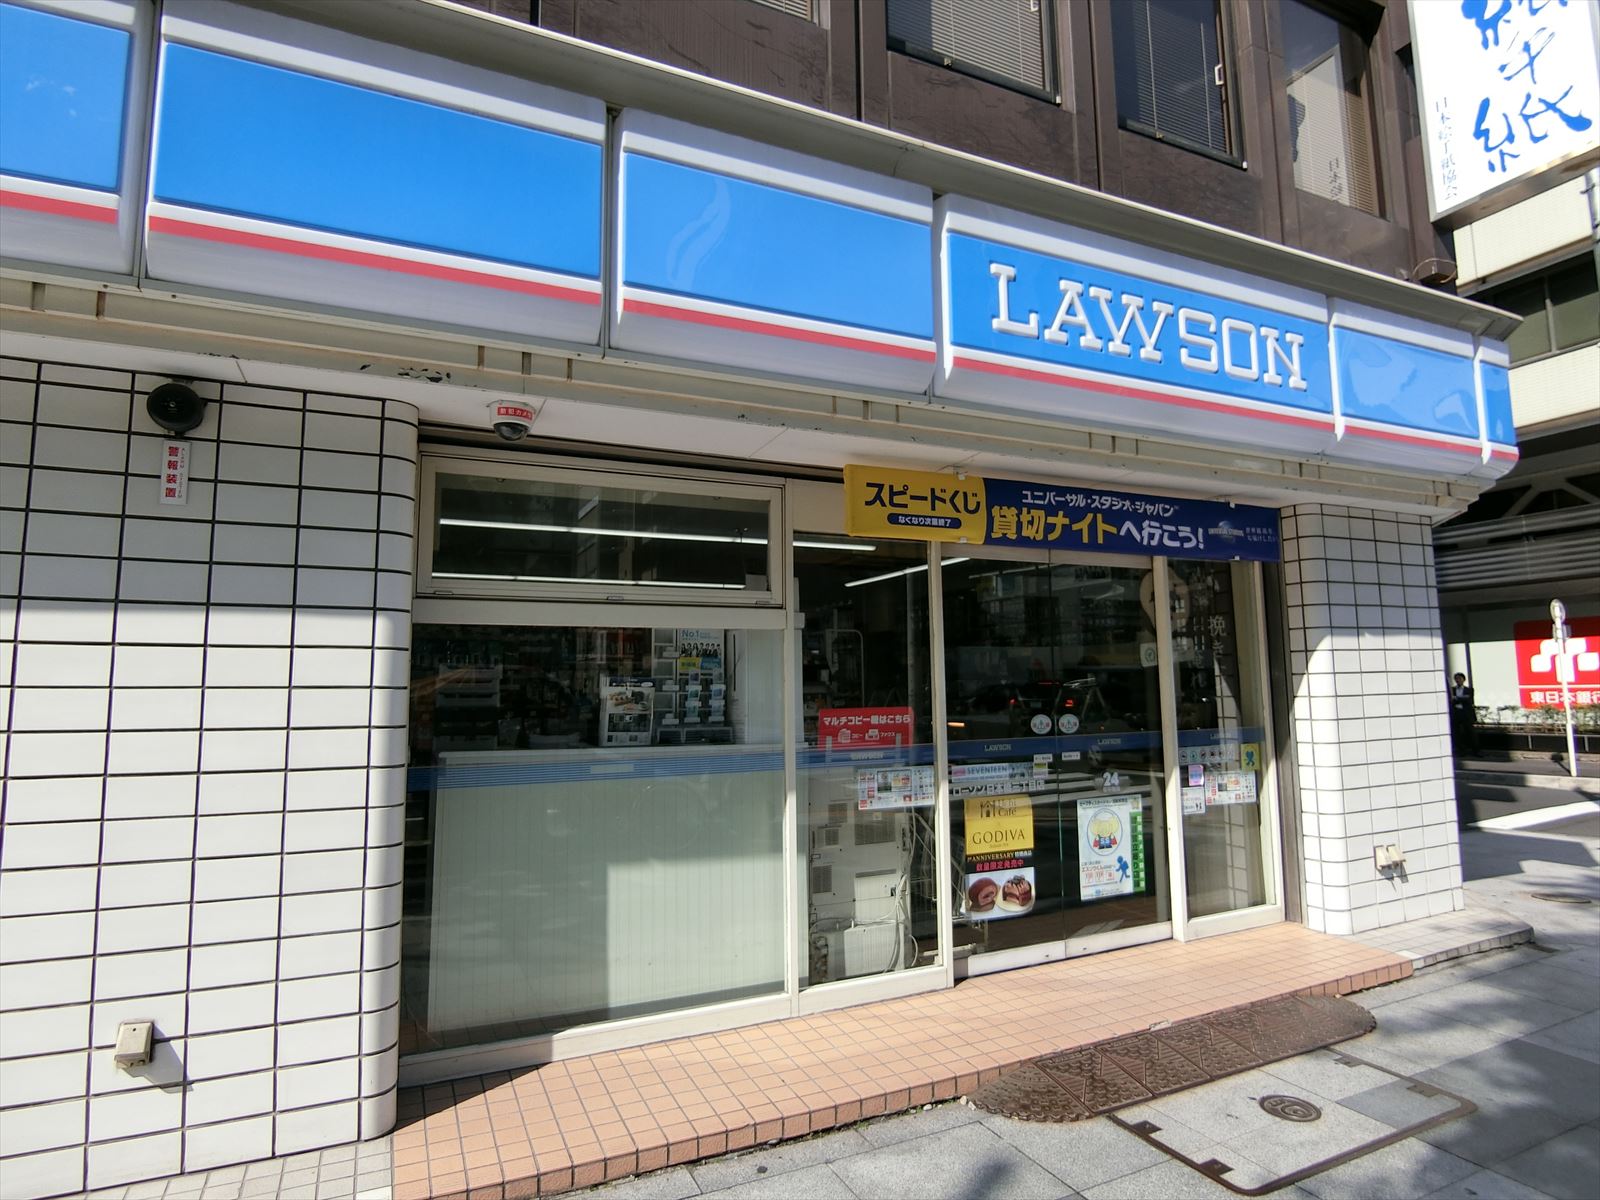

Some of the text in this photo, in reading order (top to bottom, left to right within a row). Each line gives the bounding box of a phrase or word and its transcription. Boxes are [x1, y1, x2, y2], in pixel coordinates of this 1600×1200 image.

[990, 262, 1308, 393] LAWSON
[864, 482, 980, 514] スピードくじ
[823, 714, 911, 726] マルチコピー機はこちら
[967, 764, 1008, 775] SEVENTEEN
[1103, 772, 1120, 787] 24
[972, 829, 1025, 845] GODIVA
[971, 852, 1014, 861] ANNIVERSARY
